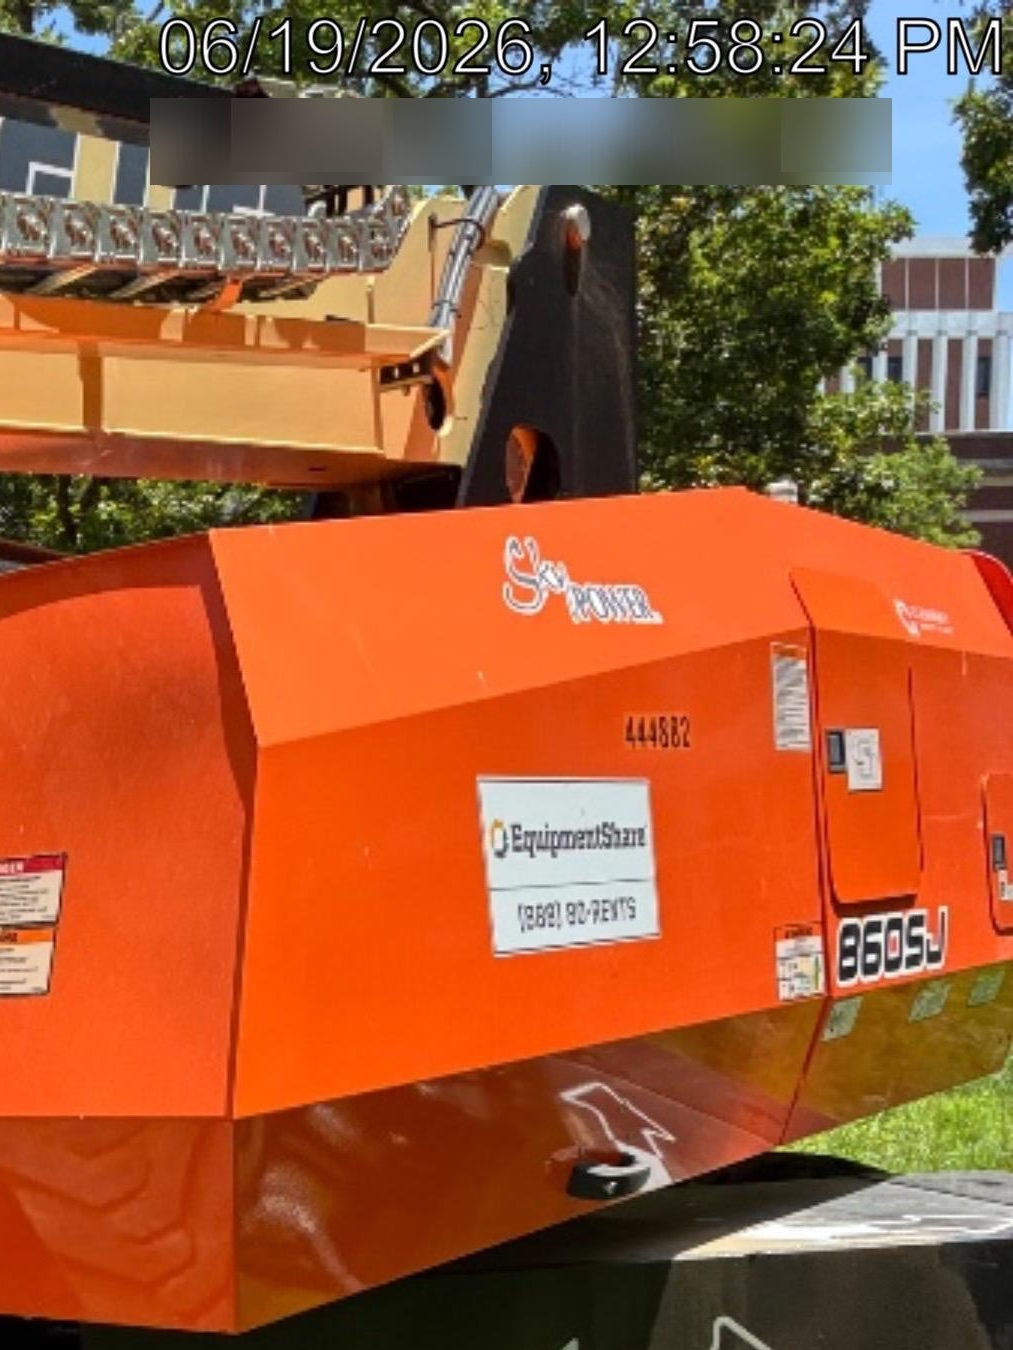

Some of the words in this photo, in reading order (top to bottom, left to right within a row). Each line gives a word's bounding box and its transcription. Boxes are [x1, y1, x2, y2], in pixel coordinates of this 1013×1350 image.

[625, 715, 692, 750] 444882
[510, 820, 648, 859] EquipmentShare
[837, 906, 949, 988] 860SJ
